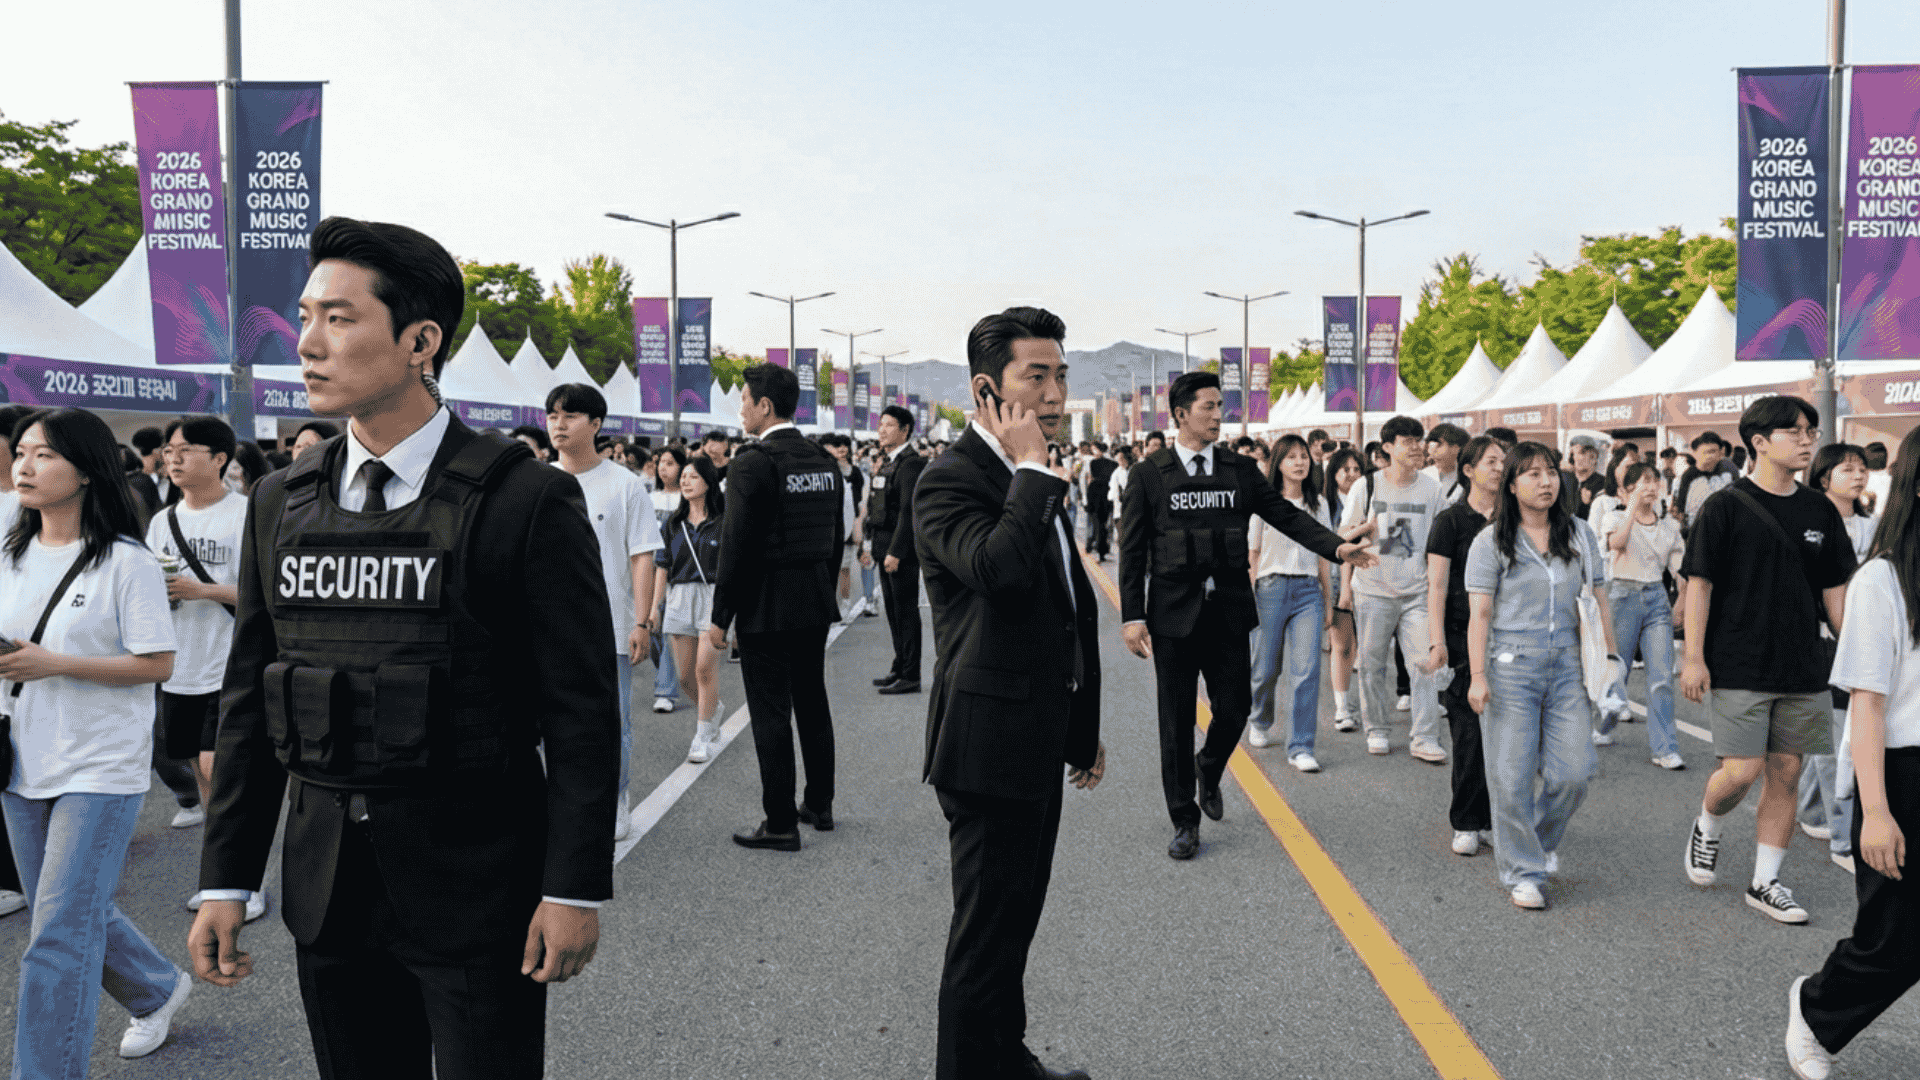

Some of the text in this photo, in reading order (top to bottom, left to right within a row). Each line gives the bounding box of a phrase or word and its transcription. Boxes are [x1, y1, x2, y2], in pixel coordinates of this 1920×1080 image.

[1867, 136, 1918, 155] 2026
[156, 151, 202, 170] 2026
[256, 151, 302, 170] 2026
[1751, 159, 1816, 178] KOREA
[150, 172, 211, 190] KOREA
[248, 172, 309, 190] KOREA
[247, 192, 310, 210] GRAND
[1753, 199, 1815, 218] MUSIC
[1858, 199, 1920, 218] MUSIC
[250, 212, 307, 230] MUSIC
[1847, 220, 1920, 238] FESTIVA
[43, 369, 88, 395] 2026
[279, 555, 437, 601] SECURITY
